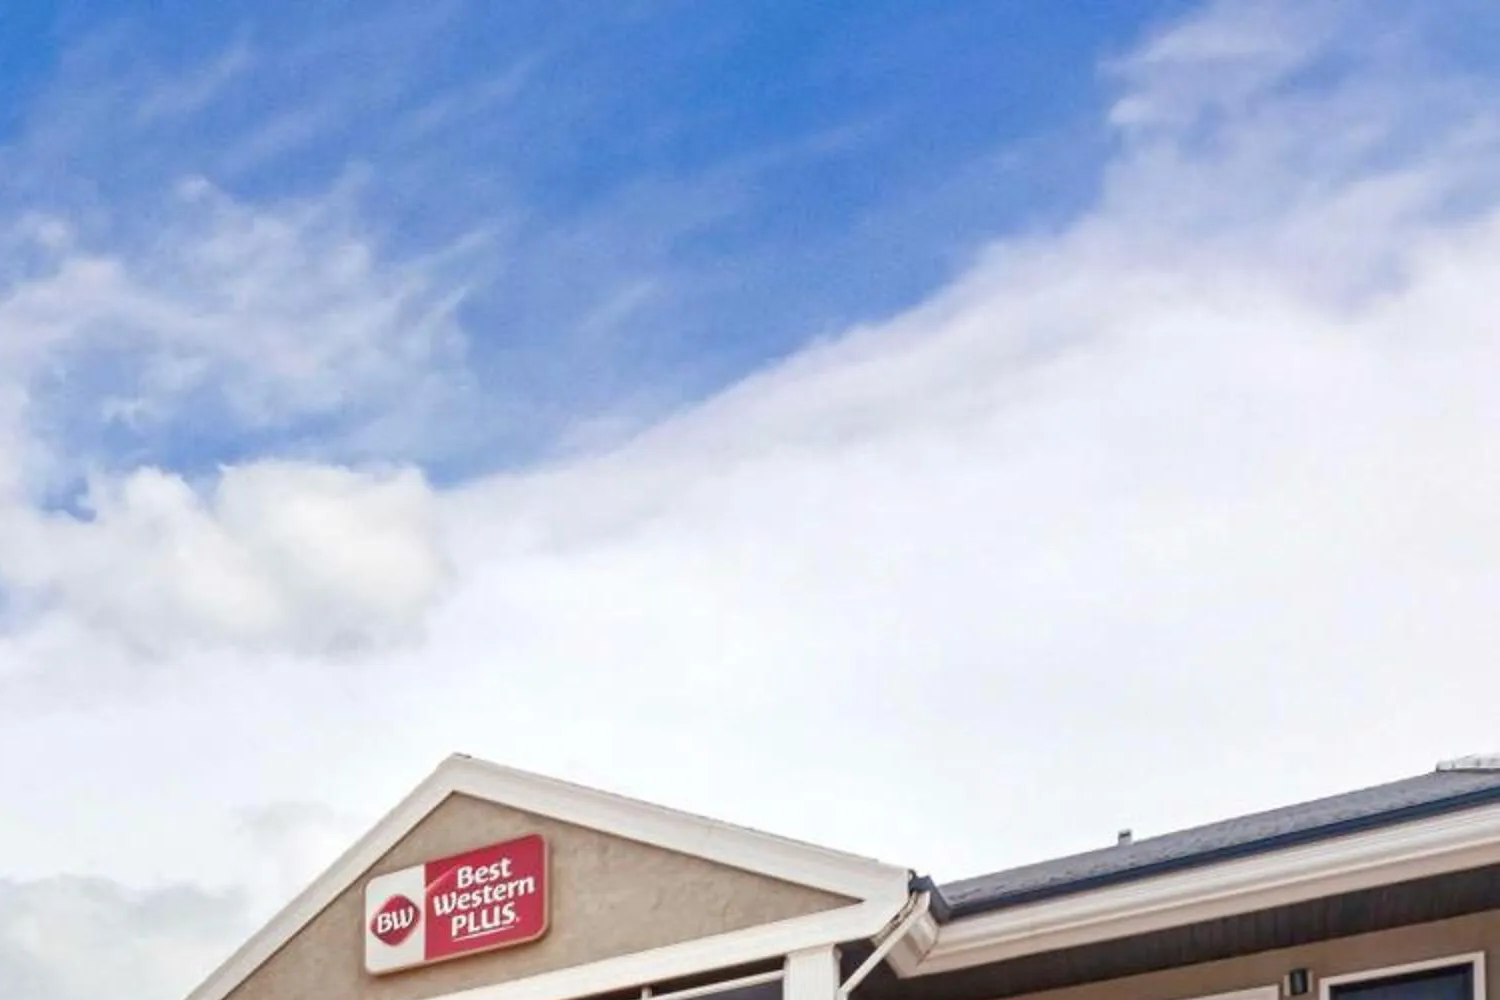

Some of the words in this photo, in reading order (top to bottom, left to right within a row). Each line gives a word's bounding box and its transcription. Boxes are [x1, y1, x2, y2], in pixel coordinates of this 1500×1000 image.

[457, 856, 512, 889] Best
[433, 877, 535, 916] Western
[376, 906, 414, 934] BW
